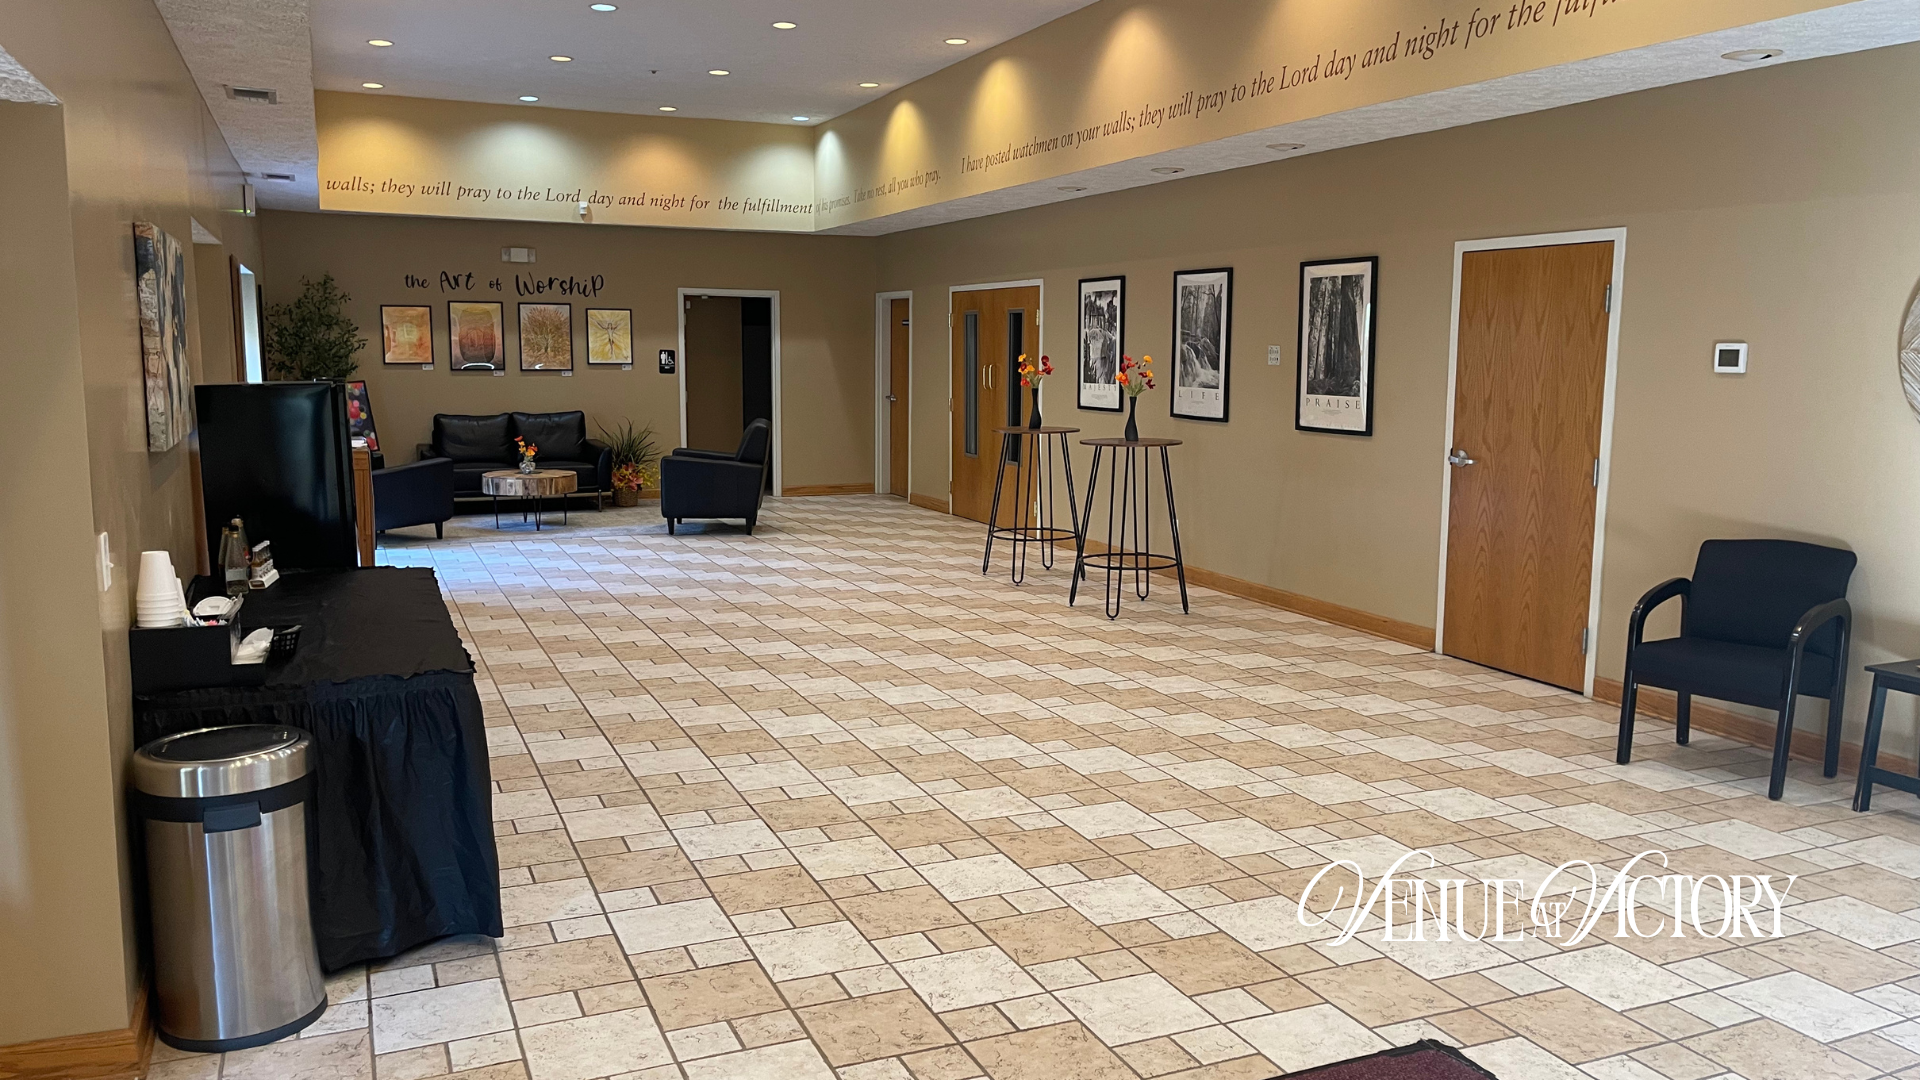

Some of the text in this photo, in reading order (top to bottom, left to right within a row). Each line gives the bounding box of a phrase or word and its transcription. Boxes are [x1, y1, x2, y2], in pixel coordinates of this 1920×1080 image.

[961, 157, 965, 174] I
[966, 155, 984, 172] have
[984, 143, 1011, 172] posted
[1012, 136, 1059, 161] watchmen
[1060, 131, 1074, 148] on
[1075, 125, 1101, 150] your
[1102, 110, 1136, 137] walls;
[1139, 104, 1165, 129] they
[1168, 91, 1194, 119] will
[1195, 89, 1227, 119] pray
[1230, 83, 1246, 103] to
[1250, 70, 1275, 98] the
[1279, 54, 1320, 91] Lord
[1323, 49, 1357, 83] day
[1361, 31, 1401, 67] and
[1404, 18, 1459, 61] night
[1464, 8, 1501, 50] for
[1507, 0, 1546, 30] the
[326, 176, 814, 215] walls; they will pray to the Lord day and night for the fulfillment
[866, 188, 875, 199] no
[887, 176, 897, 194] all
[896, 180, 909, 195] you
[909, 170, 924, 189] who
[924, 169, 942, 188] pray.
[404, 274, 430, 289] the
[439, 270, 476, 293] Art
[489, 278, 503, 291] of
[1178, 390, 1220, 401] LIFE
[1305, 397, 1361, 410] PRAISE
